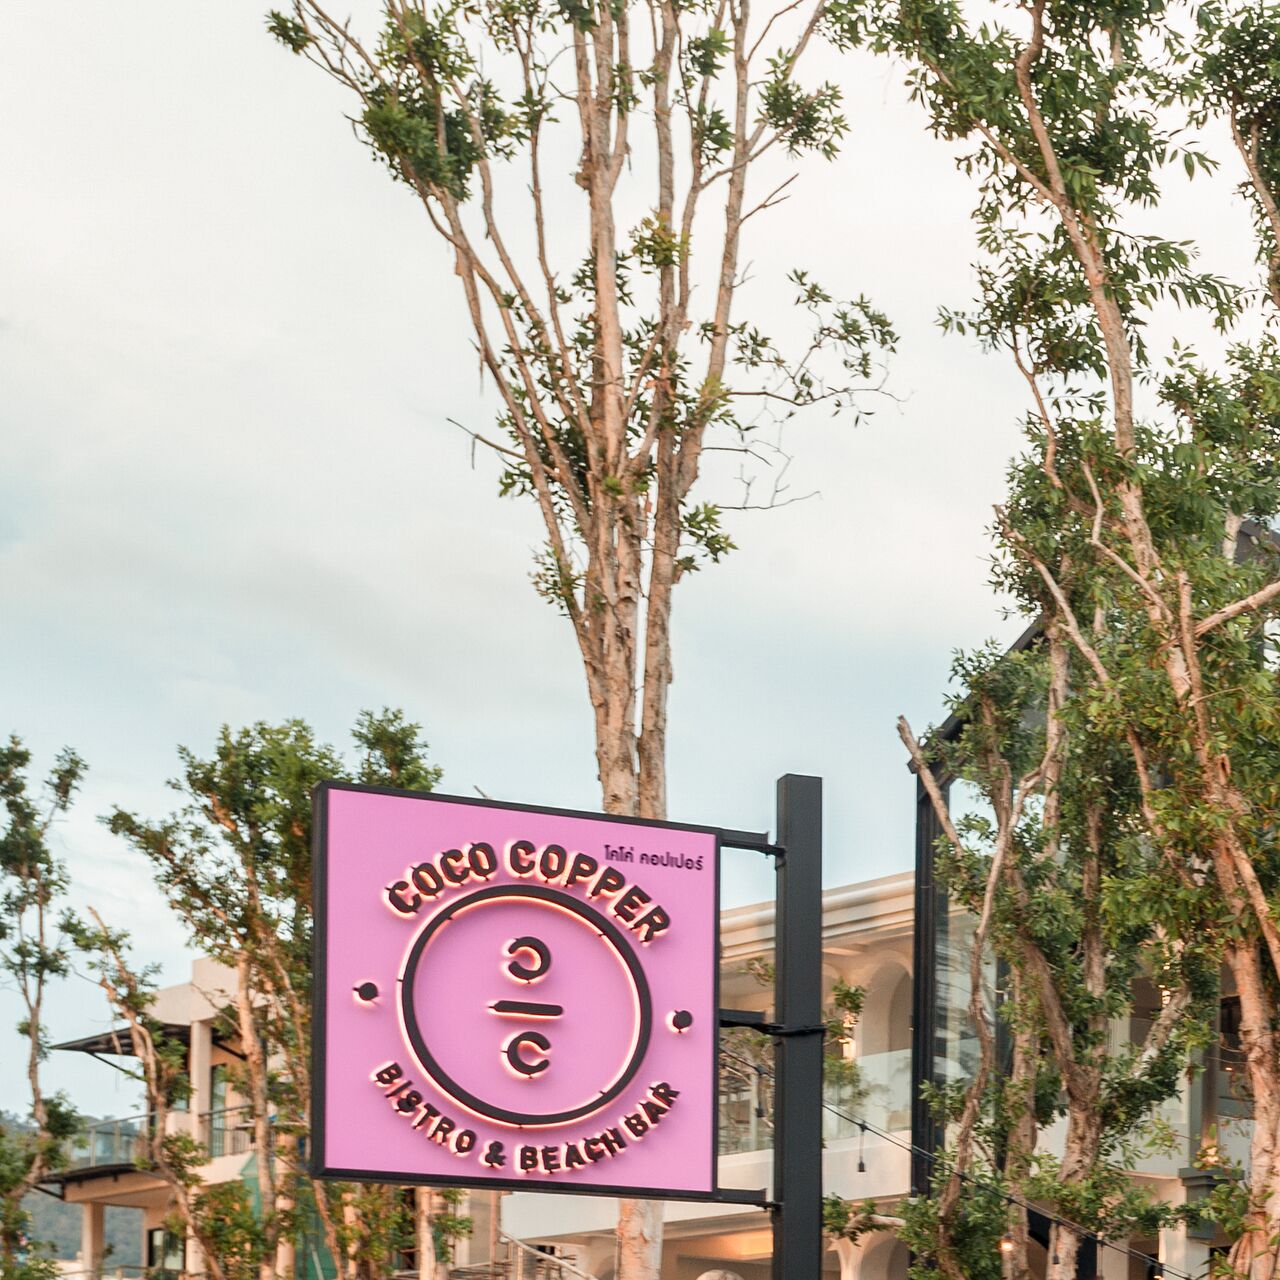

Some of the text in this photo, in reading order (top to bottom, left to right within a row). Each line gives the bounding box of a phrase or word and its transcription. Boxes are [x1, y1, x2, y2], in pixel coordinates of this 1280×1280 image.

[386, 840, 671, 944] COCO COPPER
[375, 1062, 680, 1172] BISTRO & BEACH BAR
